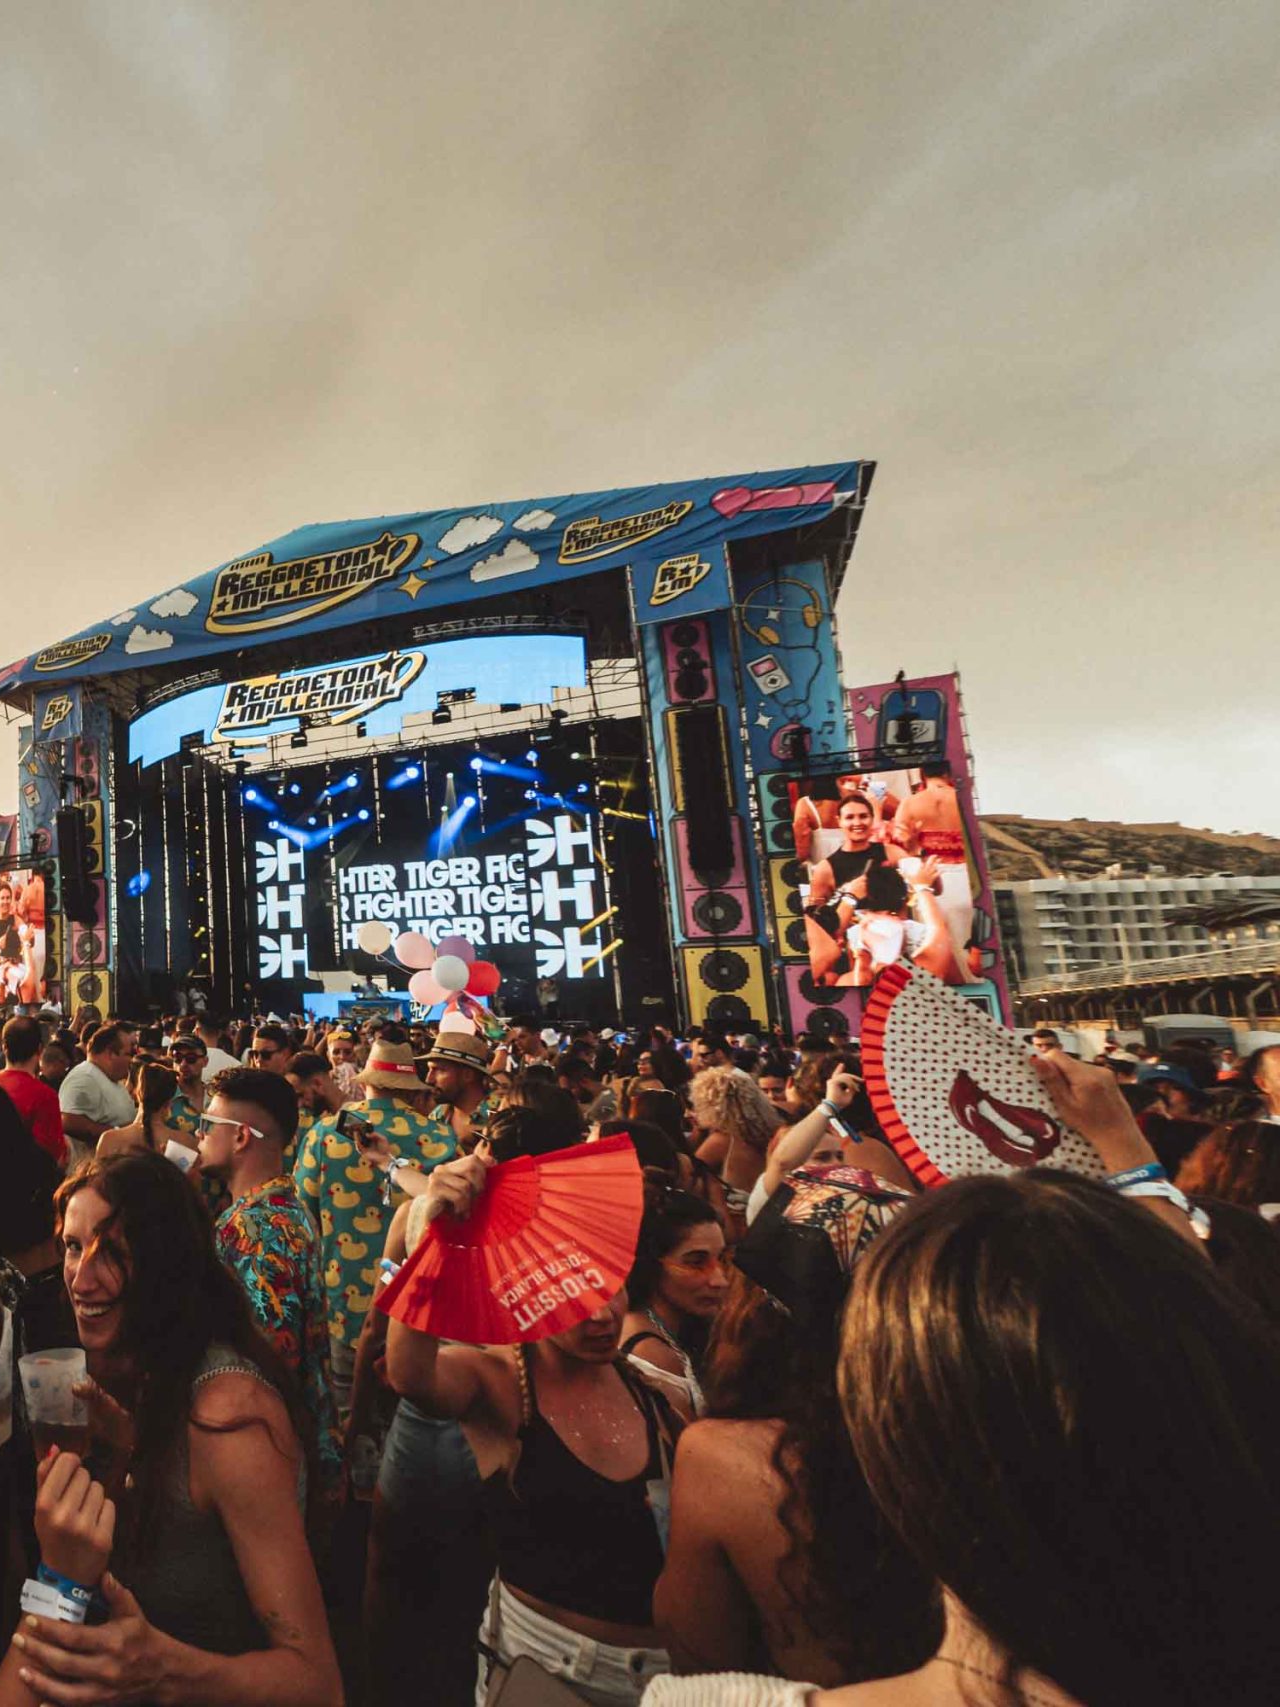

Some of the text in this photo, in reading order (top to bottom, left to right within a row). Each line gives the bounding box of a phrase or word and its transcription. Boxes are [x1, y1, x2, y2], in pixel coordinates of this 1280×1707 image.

[217, 547, 371, 597] REGGAETON
[659, 567, 677, 582] R
[225, 664, 376, 708] REGGAETON
[404, 857, 482, 890] TIGER
[354, 888, 460, 920] FIGHTER
[499, 1268, 548, 1309] BLANCA
